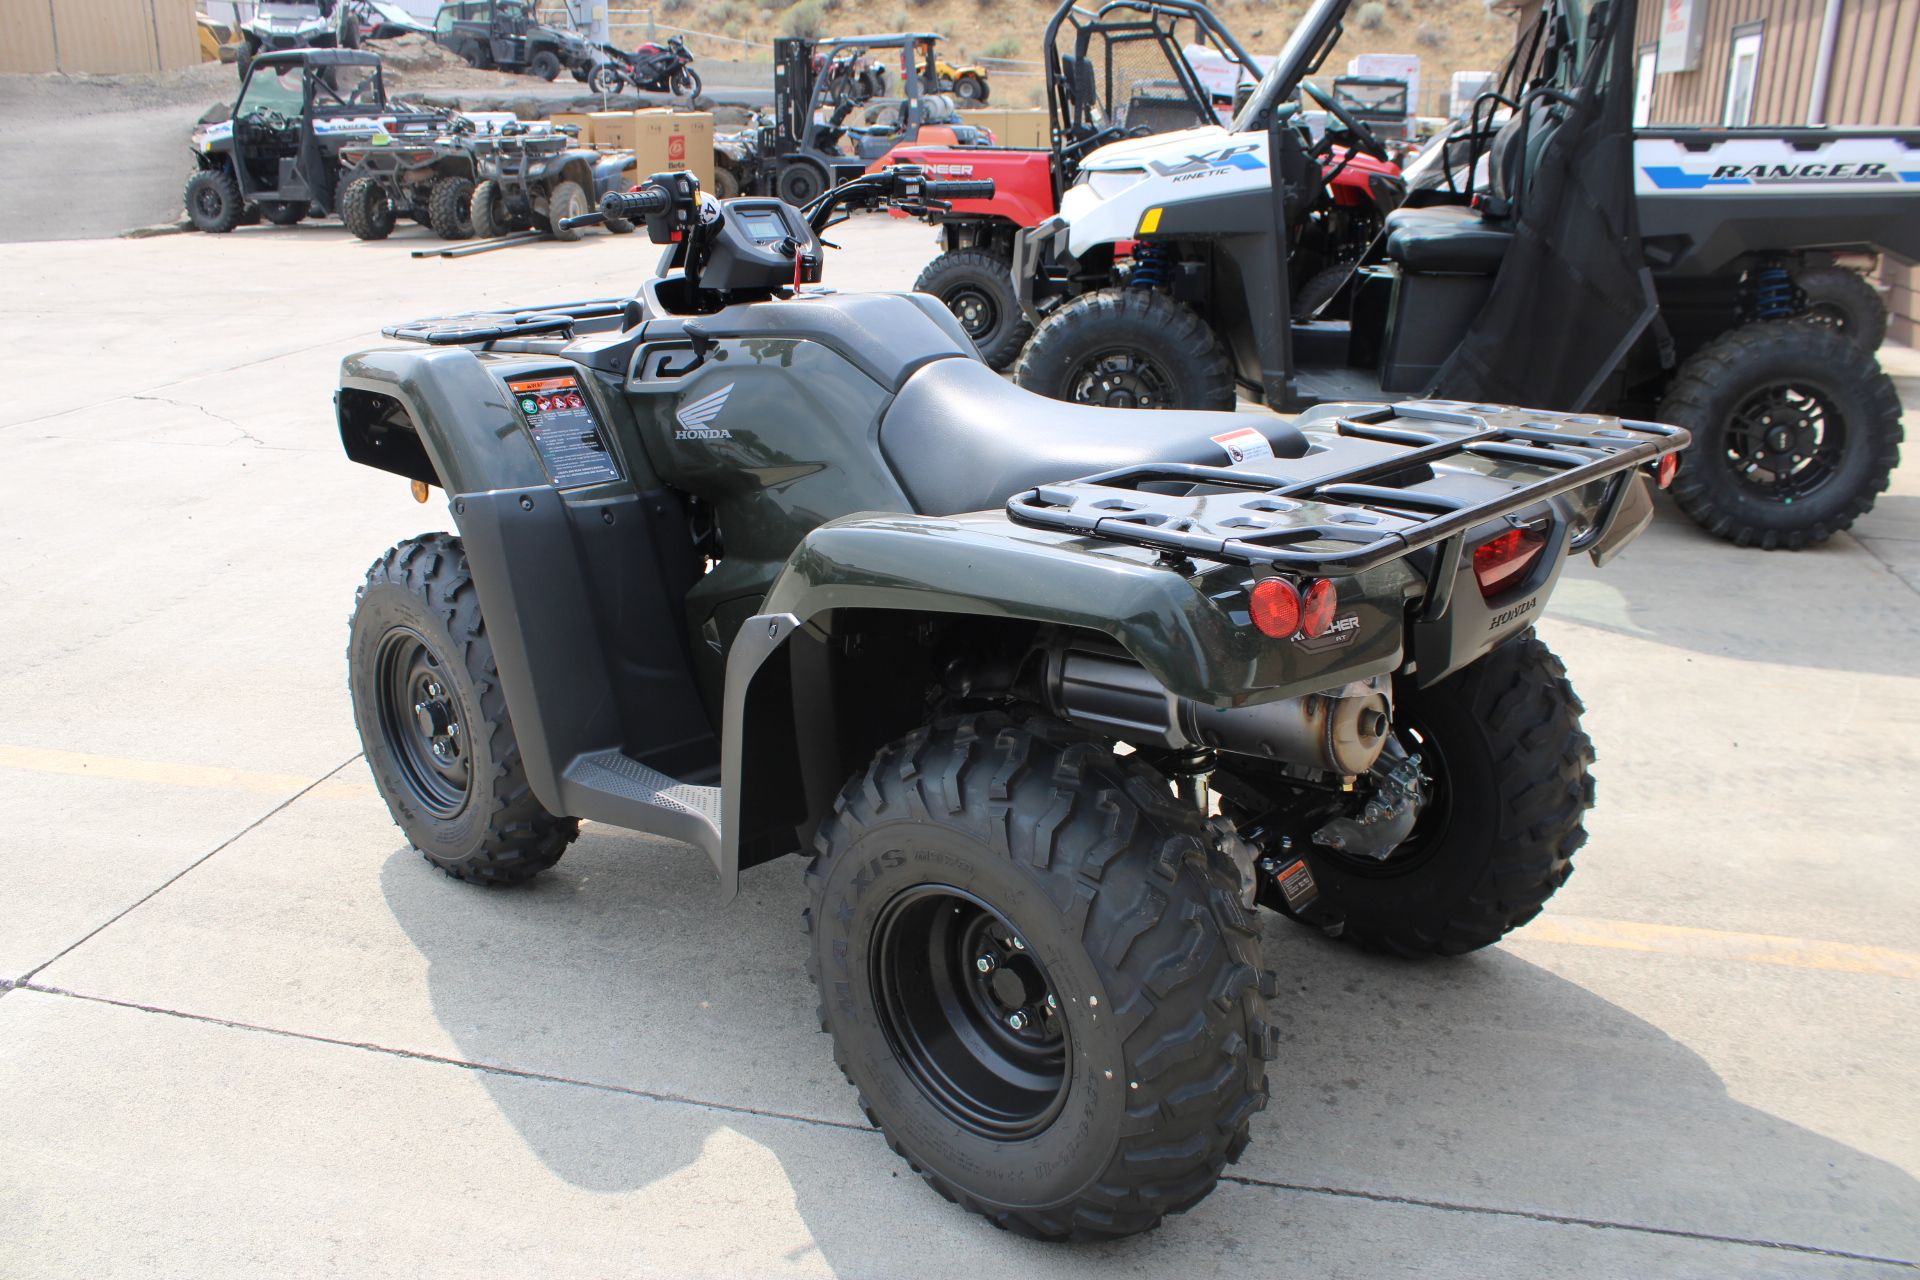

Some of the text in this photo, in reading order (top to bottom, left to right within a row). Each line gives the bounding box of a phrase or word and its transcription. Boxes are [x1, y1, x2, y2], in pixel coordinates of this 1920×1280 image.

[920, 165, 974, 175] NEER
[1173, 168, 1230, 182] KINETIC
[1710, 163, 1888, 178] RANGER
[675, 429, 732, 440] HONDA
[1488, 597, 1537, 631] HONDA
